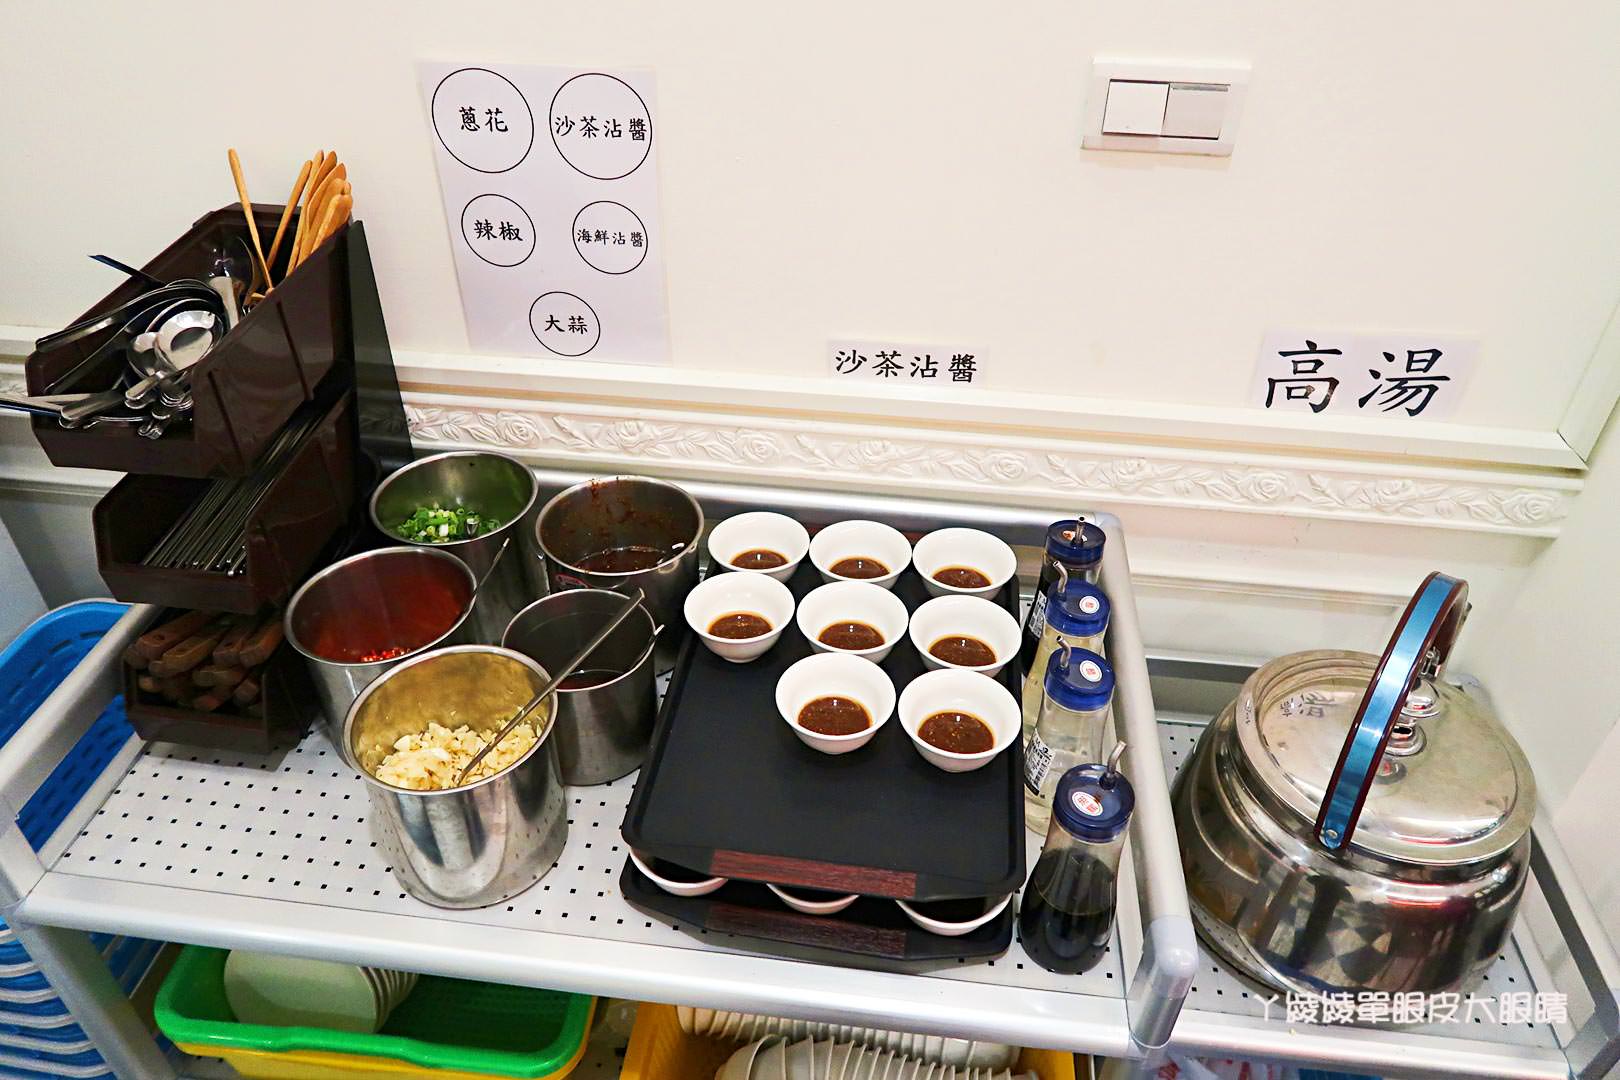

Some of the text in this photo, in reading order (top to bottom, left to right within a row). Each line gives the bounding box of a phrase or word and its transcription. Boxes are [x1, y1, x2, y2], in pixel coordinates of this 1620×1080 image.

[458, 106, 509, 132] 蔥花
[554, 115, 648, 141] 沙茶沾醬
[473, 218, 523, 242] 辣椒
[576, 228, 644, 247] 海鮮沾醬
[544, 314, 588, 335] 大蒜
[834, 349, 977, 383] 沙茶沾醬
[1265, 339, 1451, 417] 高湯
